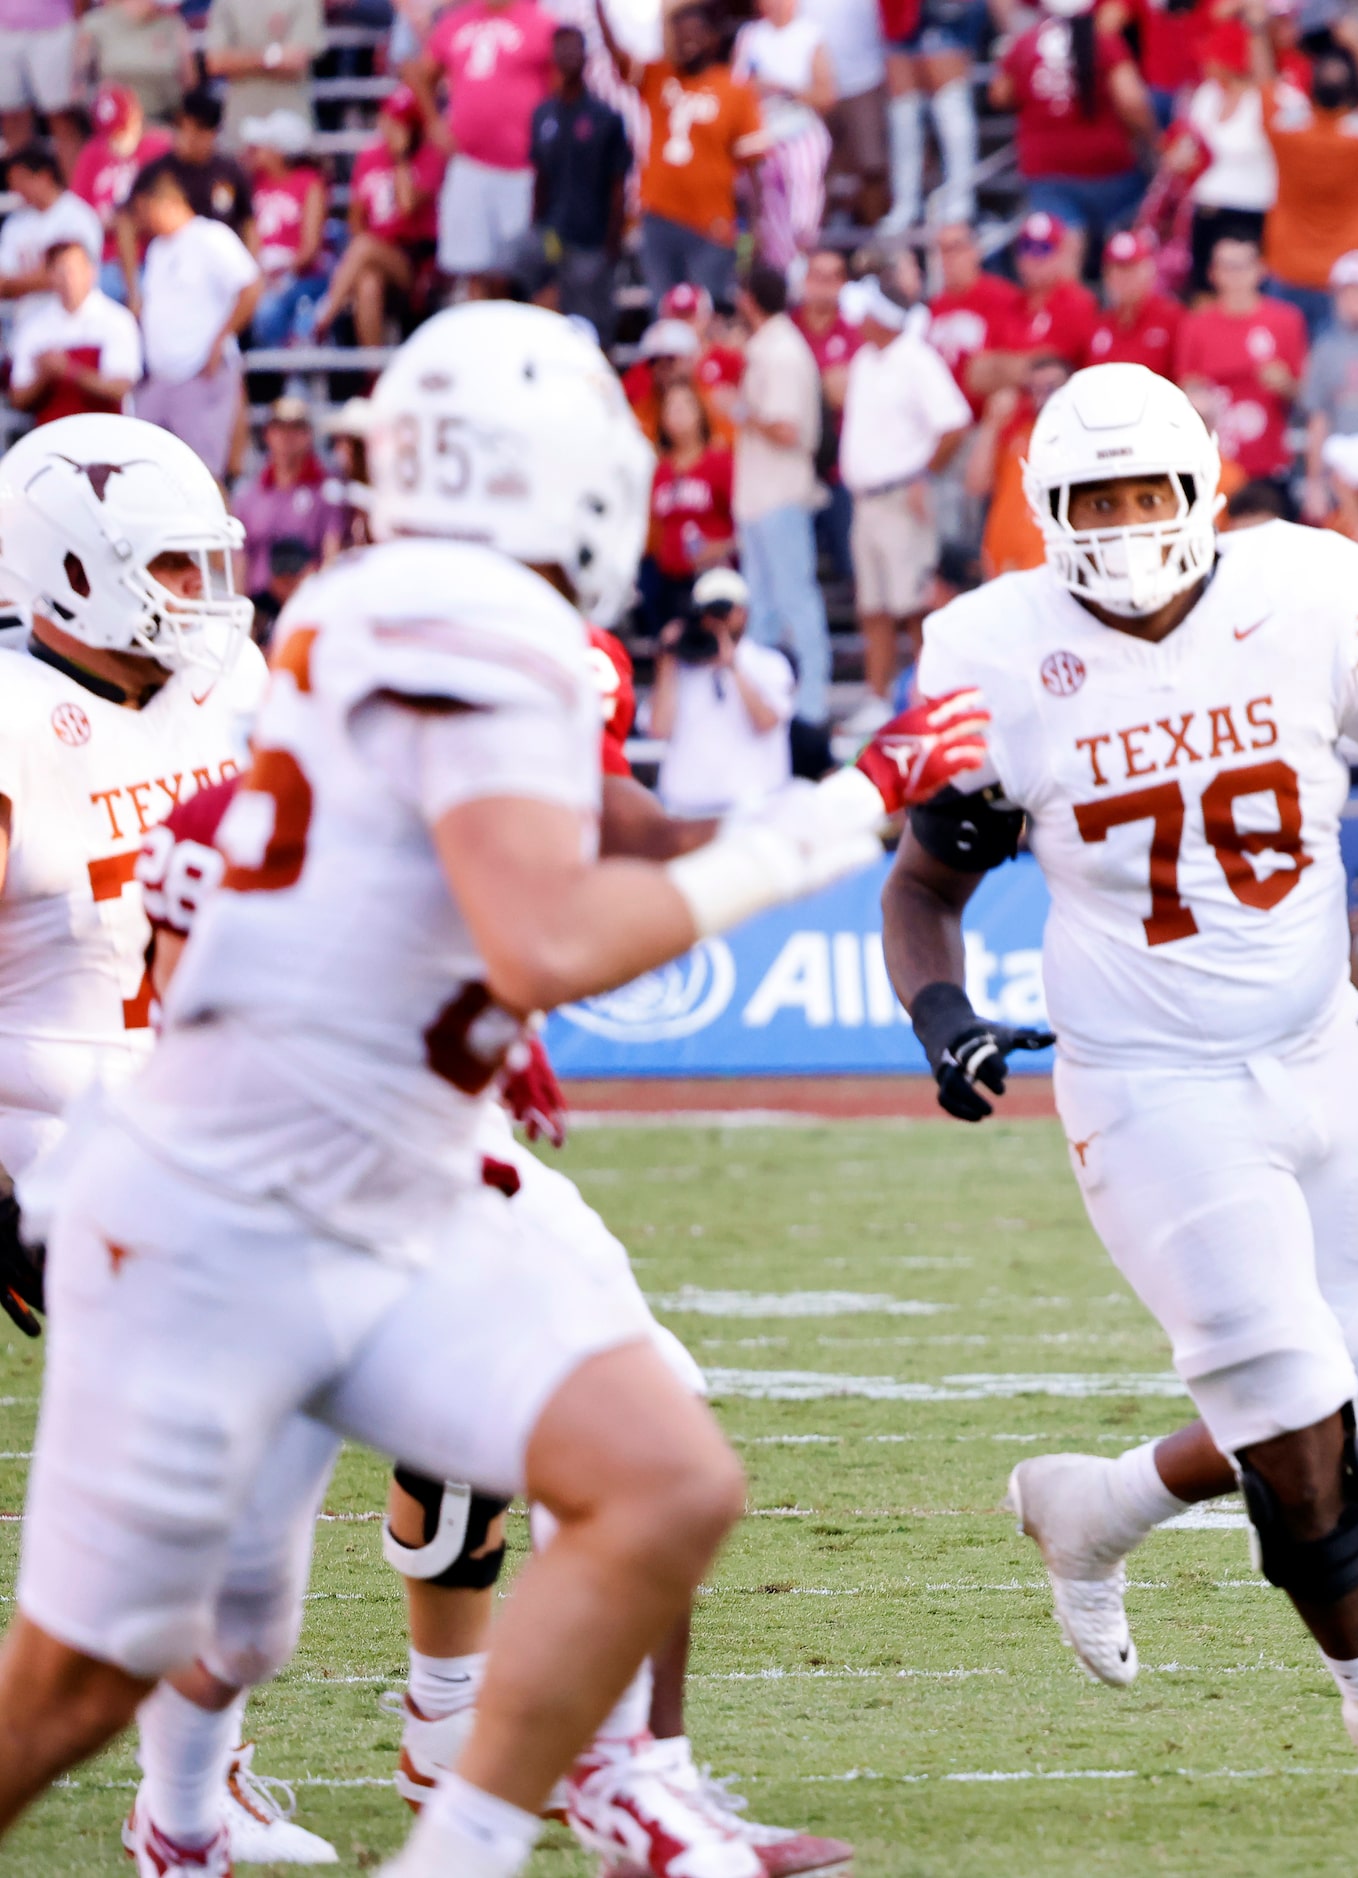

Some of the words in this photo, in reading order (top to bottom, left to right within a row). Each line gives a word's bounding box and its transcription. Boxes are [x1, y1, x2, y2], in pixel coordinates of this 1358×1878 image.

[1041, 651, 1086, 698] SEC
[52, 702, 92, 746] SEC
[1074, 694, 1279, 787] TEXAS
[1072, 758, 1314, 947] 78
